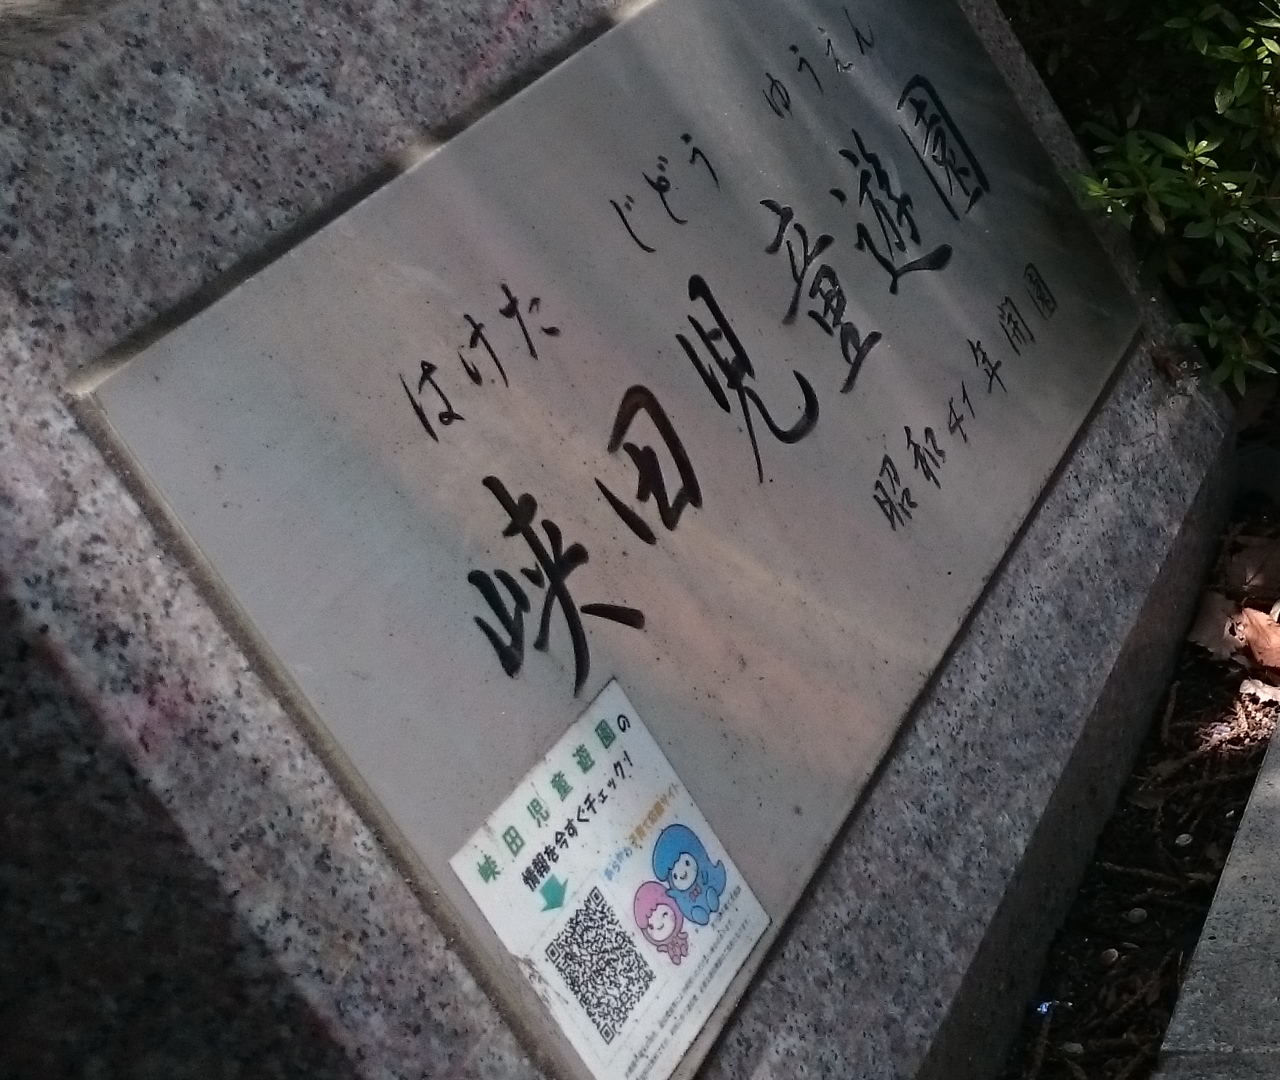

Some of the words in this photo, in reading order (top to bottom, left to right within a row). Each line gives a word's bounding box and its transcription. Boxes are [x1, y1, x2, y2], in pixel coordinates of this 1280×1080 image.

[399, 283, 561, 443] はけた
[609, 132, 720, 254] じどう
[762, 5, 875, 119] ゆうえん
[467, 73, 991, 699] 峡田児童遊園
[872, 262, 1059, 532] 昭和41年開園
[477, 713, 632, 885] 峡田児童遊園の
